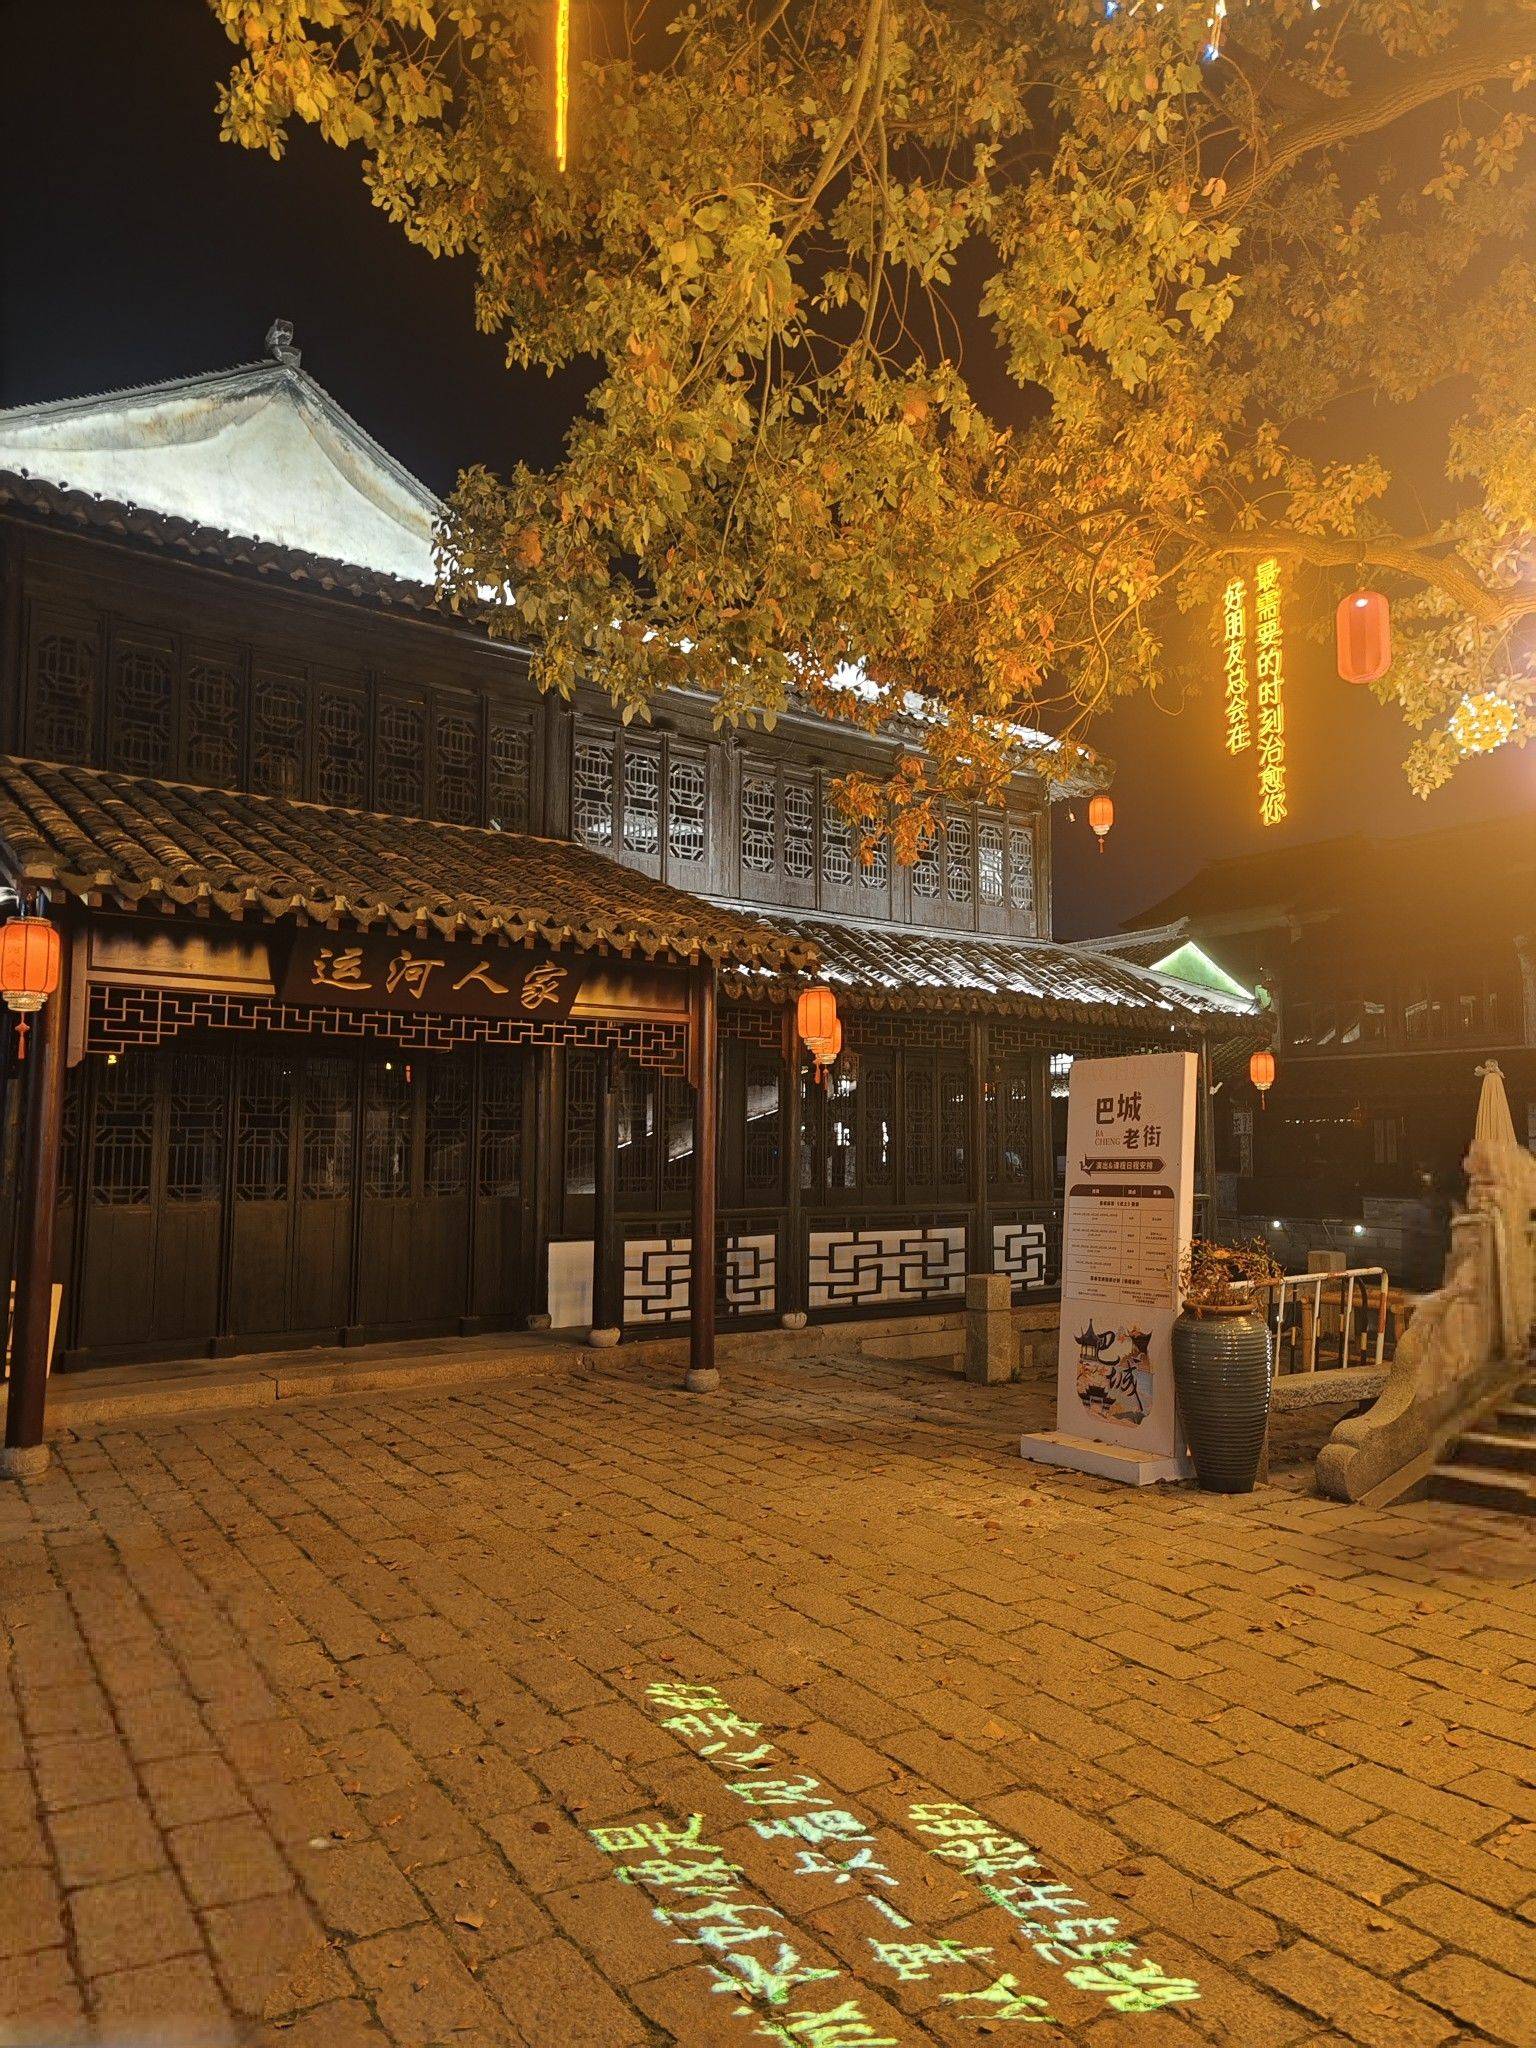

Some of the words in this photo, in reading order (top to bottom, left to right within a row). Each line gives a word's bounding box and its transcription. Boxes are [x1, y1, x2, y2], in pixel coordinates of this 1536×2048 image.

[1222, 578, 1251, 755] 好朋友总会在
[1254, 557, 1288, 826] 最需要的时刻治愈你
[311, 947, 569, 1010] 运河人家
[1096, 1091, 1142, 1125] 巴城
[1095, 1137, 1120, 1146] CHENG
[1123, 1125, 1161, 1149] 老街
